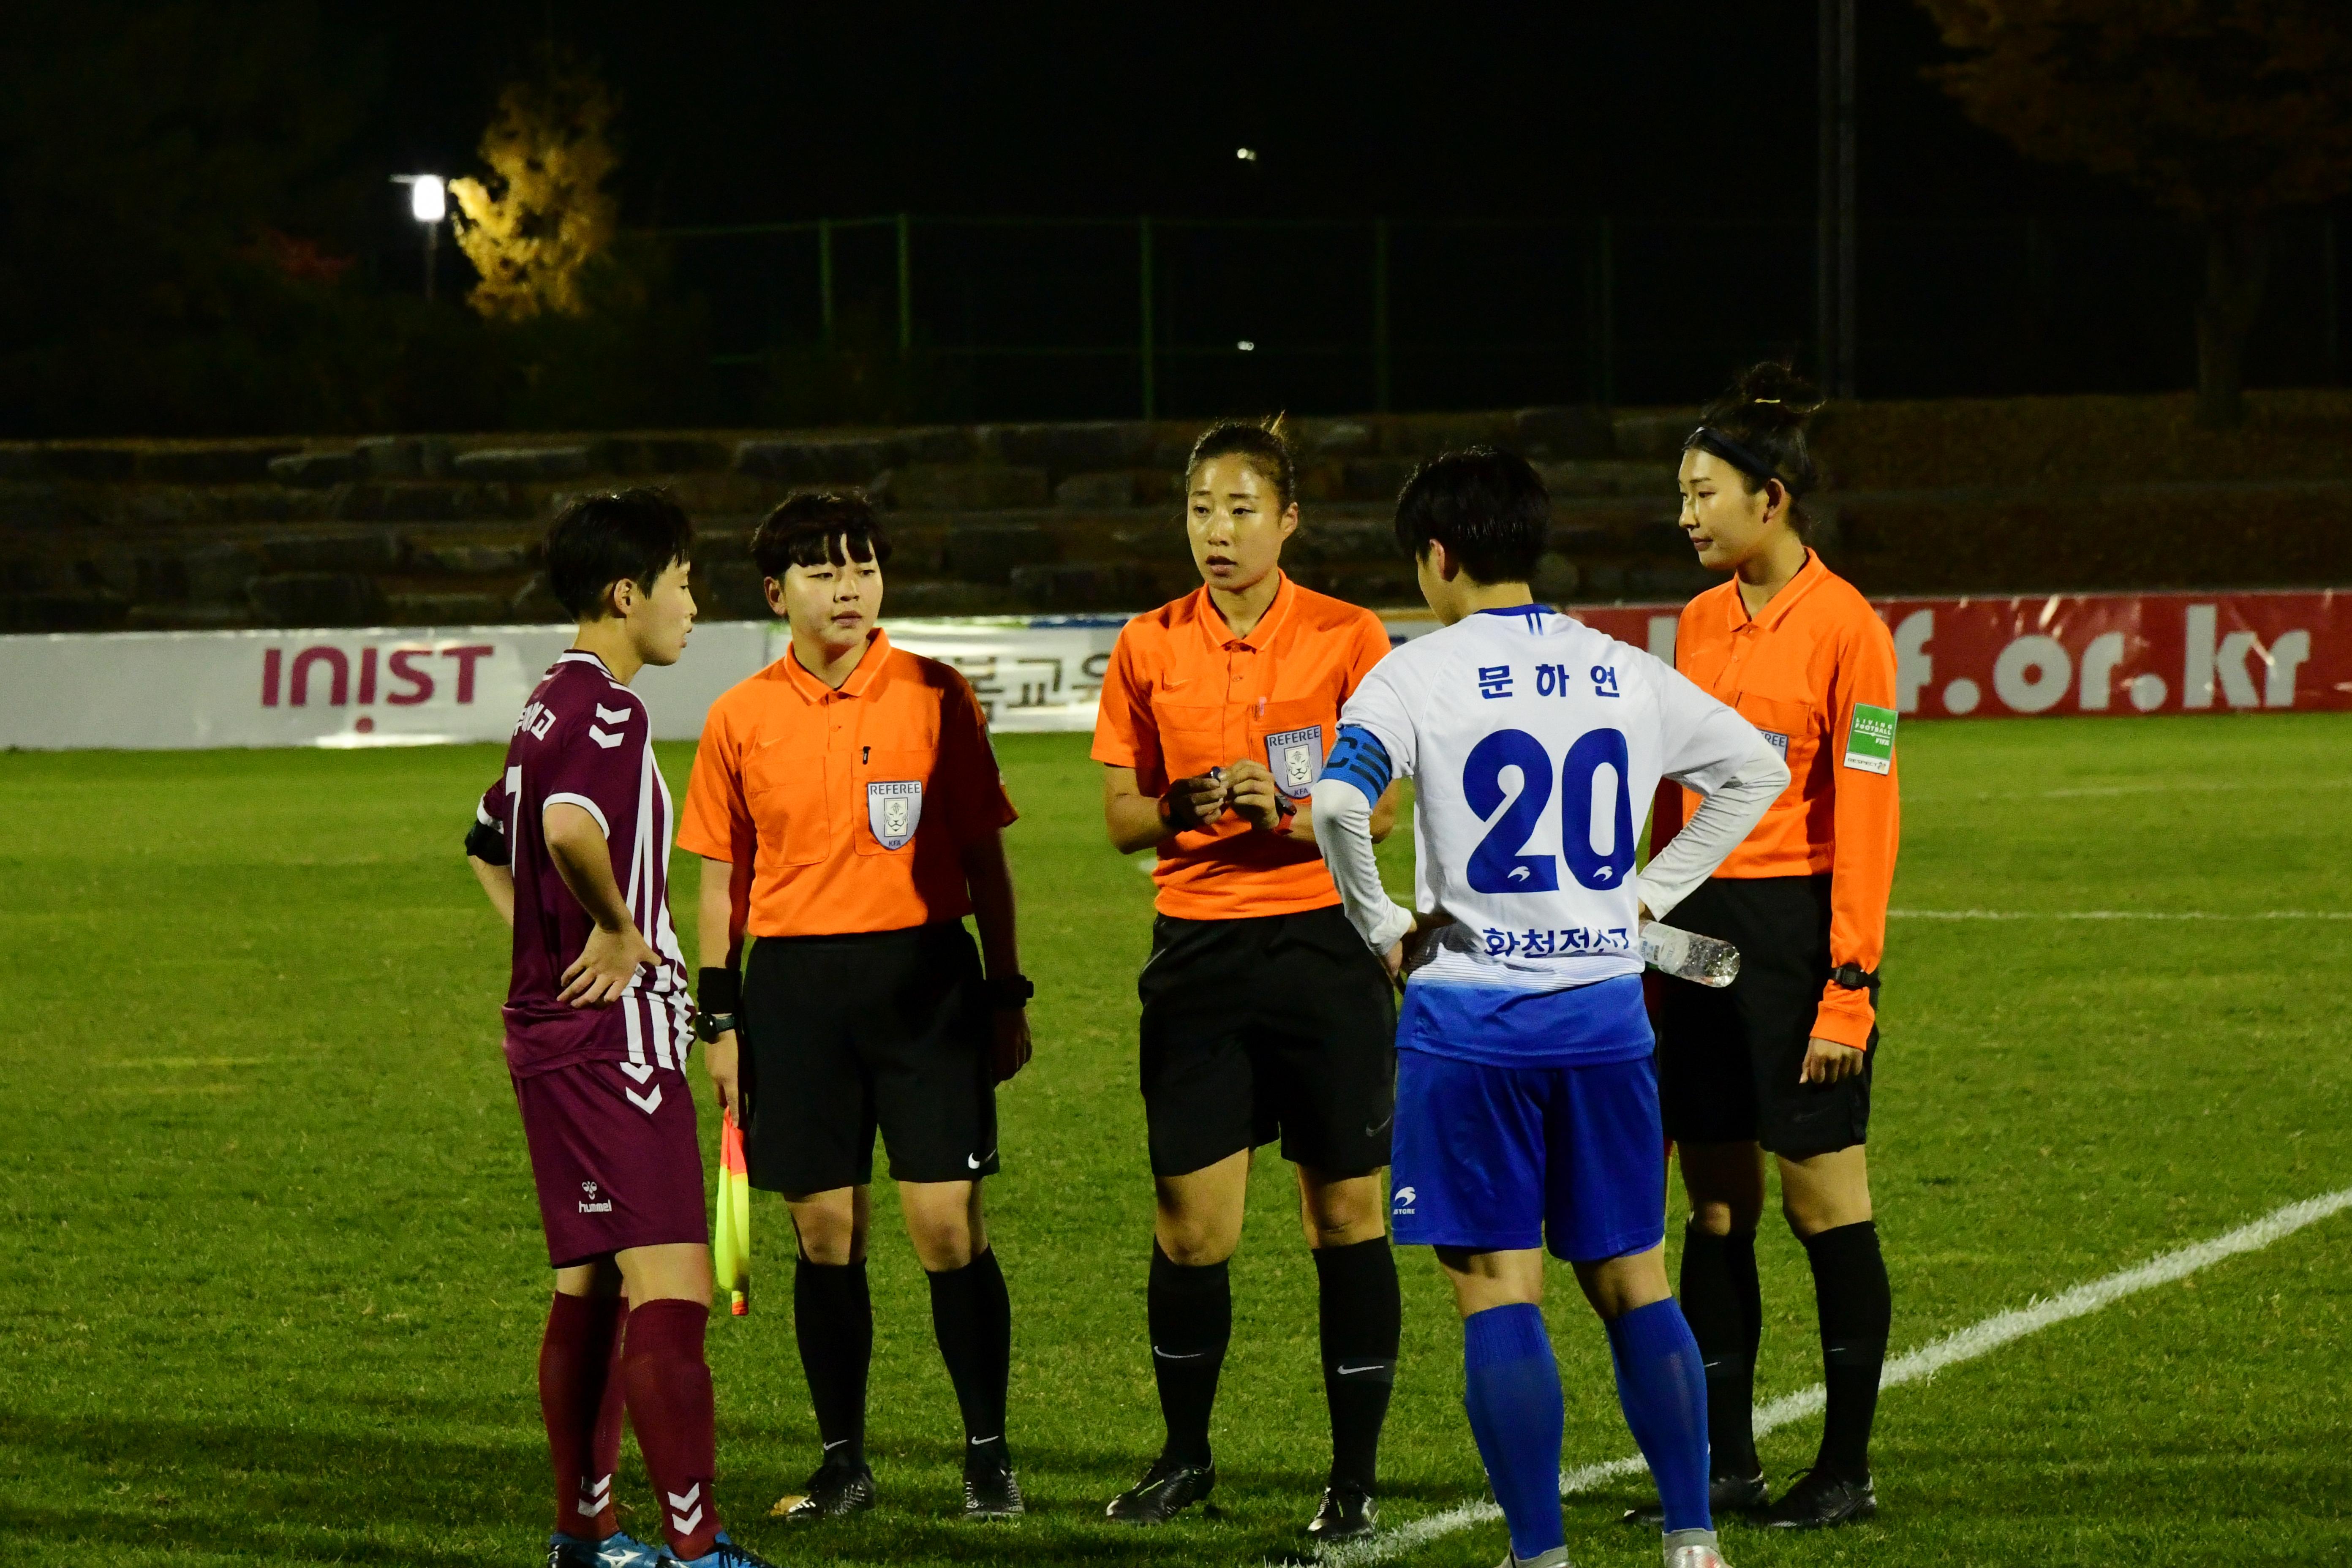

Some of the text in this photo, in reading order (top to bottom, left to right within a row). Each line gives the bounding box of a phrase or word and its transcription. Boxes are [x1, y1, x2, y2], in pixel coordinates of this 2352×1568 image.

[1855, 723, 1891, 735] FOOTBALL
[1856, 718, 1892, 730] LIVING
[1269, 727, 1320, 747] REFEREE
[1876, 738, 1890, 746] FIFA
[1848, 758, 1877, 767] RESPECT
[870, 783, 920, 795] REFEREE
[1294, 788, 1309, 797] KFA
[1463, 728, 1636, 894] 20
[578, 1199, 612, 1213] hummel
